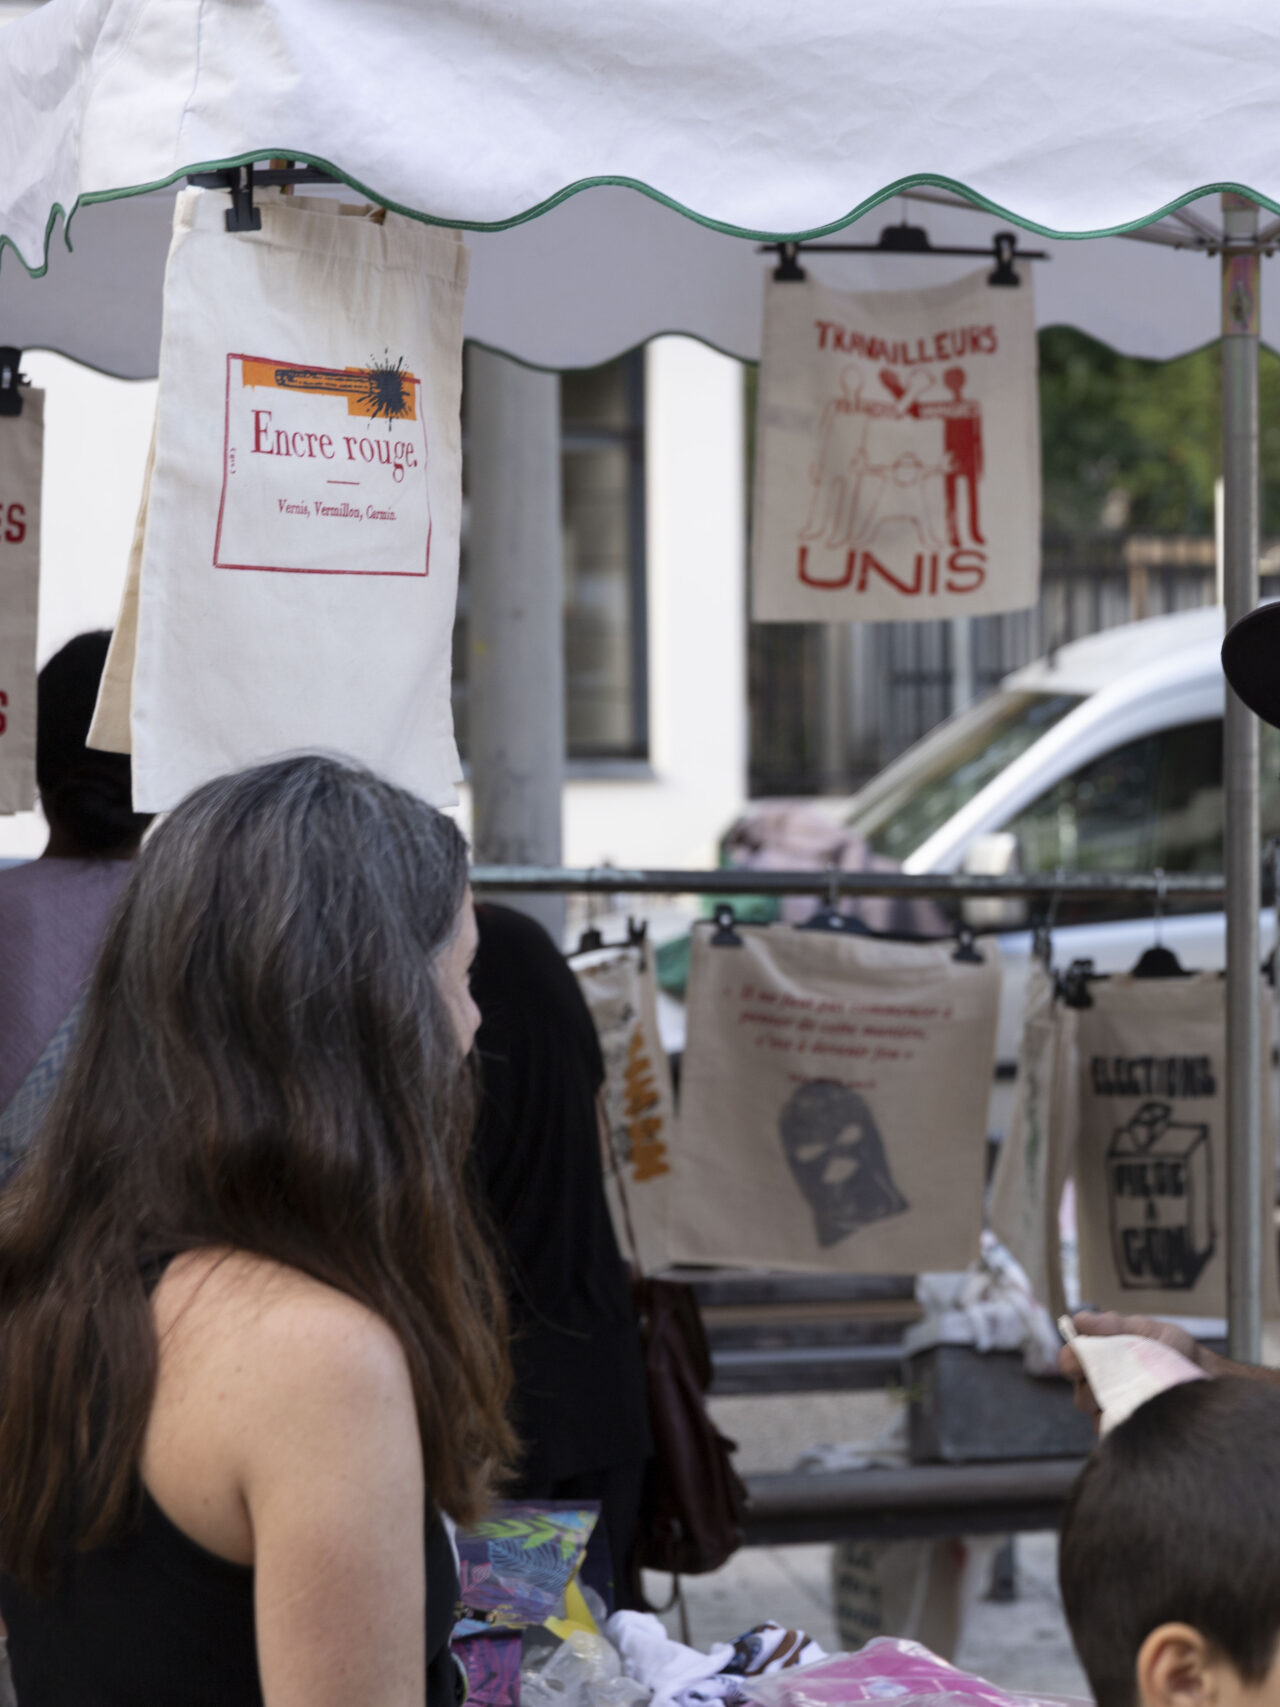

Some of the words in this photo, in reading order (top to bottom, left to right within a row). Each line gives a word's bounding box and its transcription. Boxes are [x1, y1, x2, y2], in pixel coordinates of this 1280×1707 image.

[814, 319, 998, 367] TRAVAILLEURS
[250, 408, 336, 460] Encre
[343, 435, 418, 484] rouge.
[278, 498, 311, 518] Vernis,
[314, 501, 363, 522] Vermillon,
[797, 546, 989, 597] UNIS
